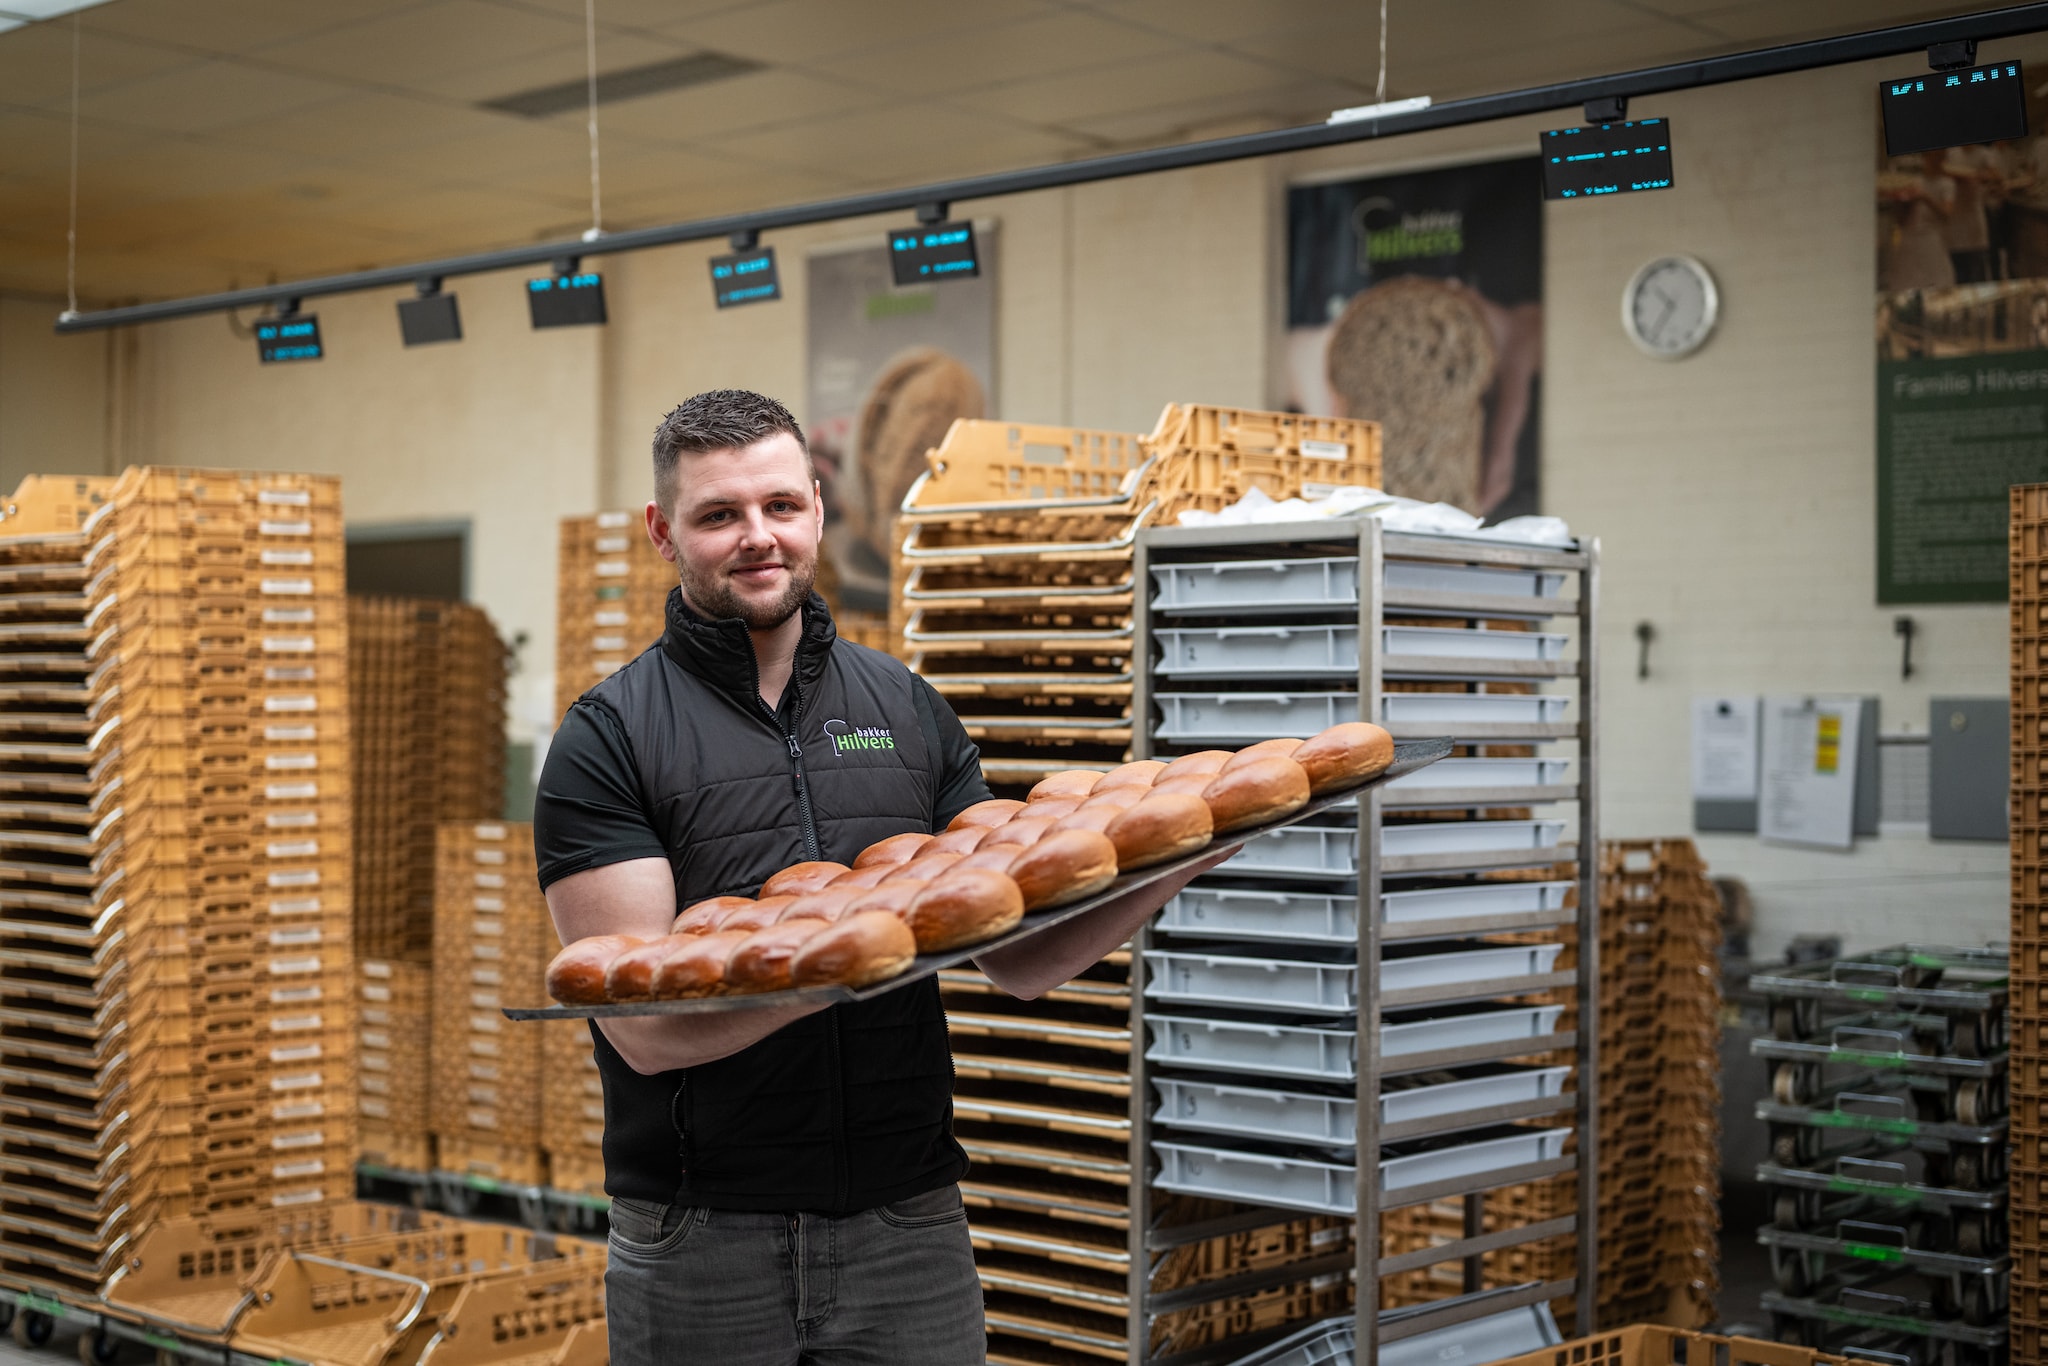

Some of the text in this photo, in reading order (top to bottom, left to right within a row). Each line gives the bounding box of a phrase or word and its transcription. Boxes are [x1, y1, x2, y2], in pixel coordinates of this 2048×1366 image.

[1894, 368, 2048, 398] Familie Hilvers
[856, 727, 890, 737] bakker
[837, 733, 894, 750] Hilvers
